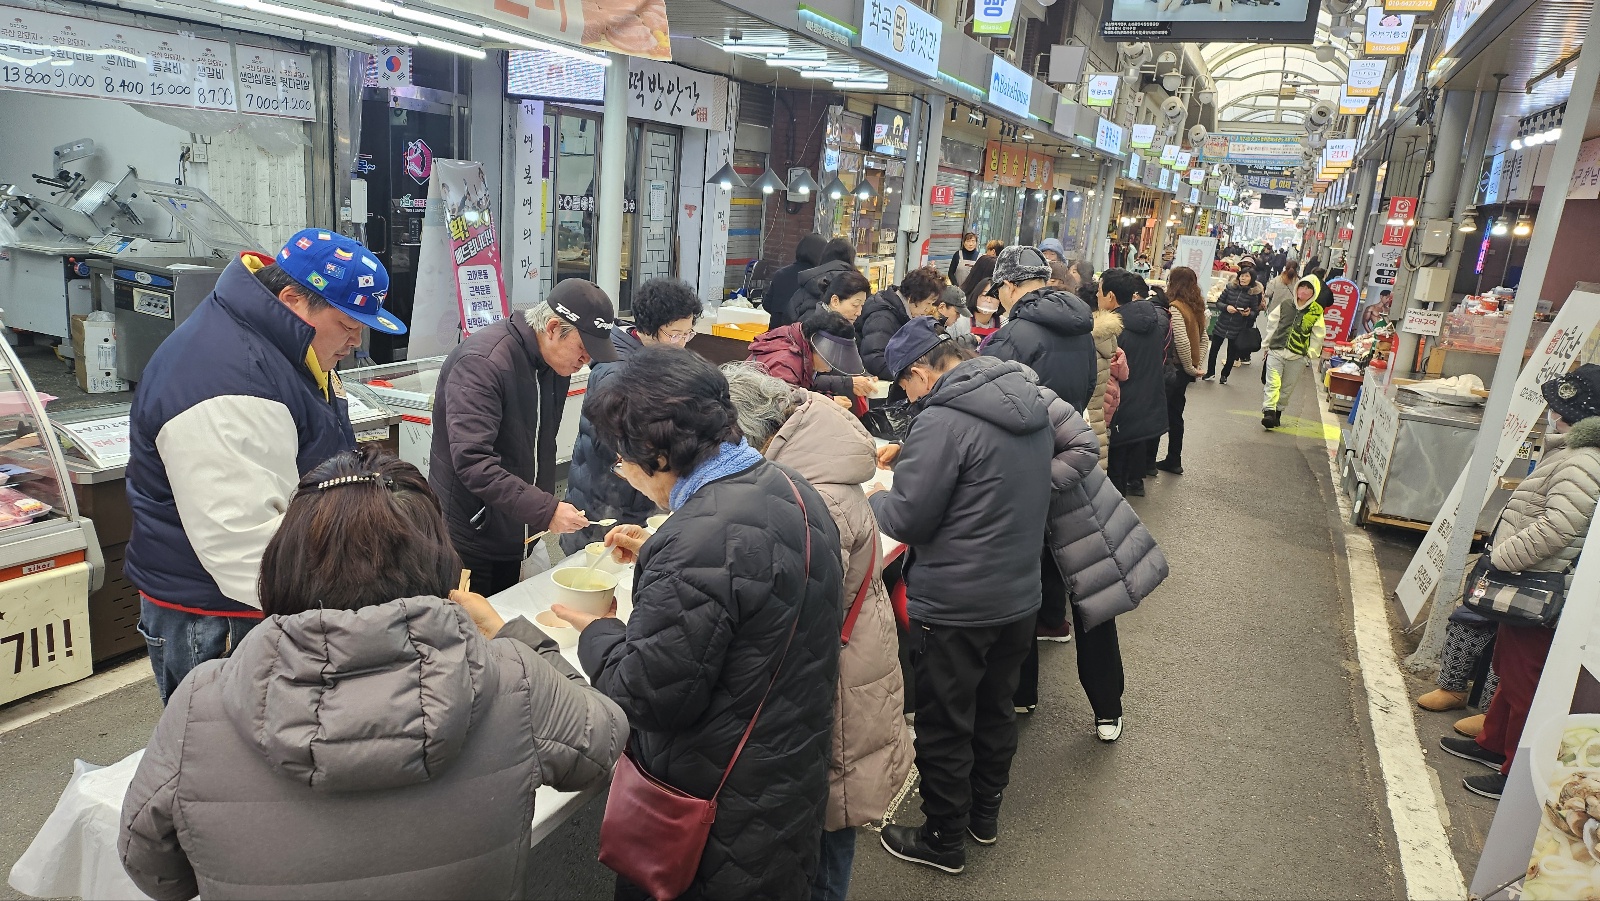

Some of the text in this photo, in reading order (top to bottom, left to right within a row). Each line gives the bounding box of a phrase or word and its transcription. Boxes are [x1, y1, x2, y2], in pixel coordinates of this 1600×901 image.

[152, 59, 182, 75] 등갈비
[197, 64, 224, 80] 생갈비
[628, 71, 700, 117] 떡방앗간
[1330, 283, 1354, 294] 태영
